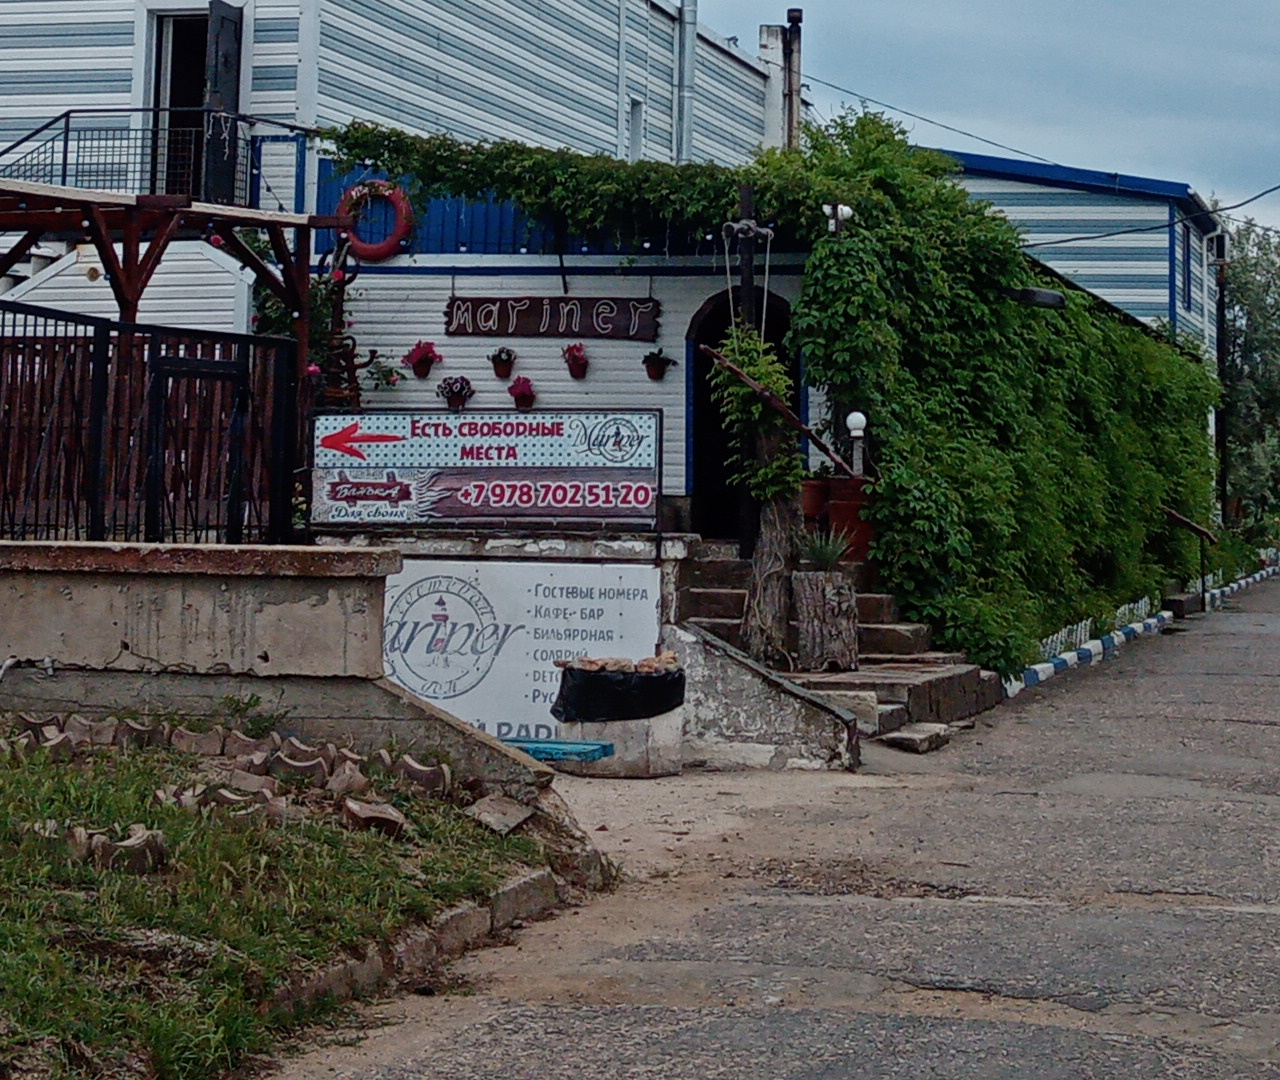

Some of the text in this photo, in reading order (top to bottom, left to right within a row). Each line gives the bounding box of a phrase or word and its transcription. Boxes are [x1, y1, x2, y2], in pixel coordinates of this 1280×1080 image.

[410, 420, 452, 437] ЕСТЬ
[569, 419, 650, 455] Mariner
[460, 446, 518, 461] МЕСТА
[460, 484, 650, 504] +7 978 702 51 20
[331, 506, 362, 520] Для
[534, 583, 648, 600] ГОСТЕВЫЕ НОМЕРА
[384, 620, 526, 657] ariner
[533, 628, 614, 641] БИЛЬЯРДНАЯ
